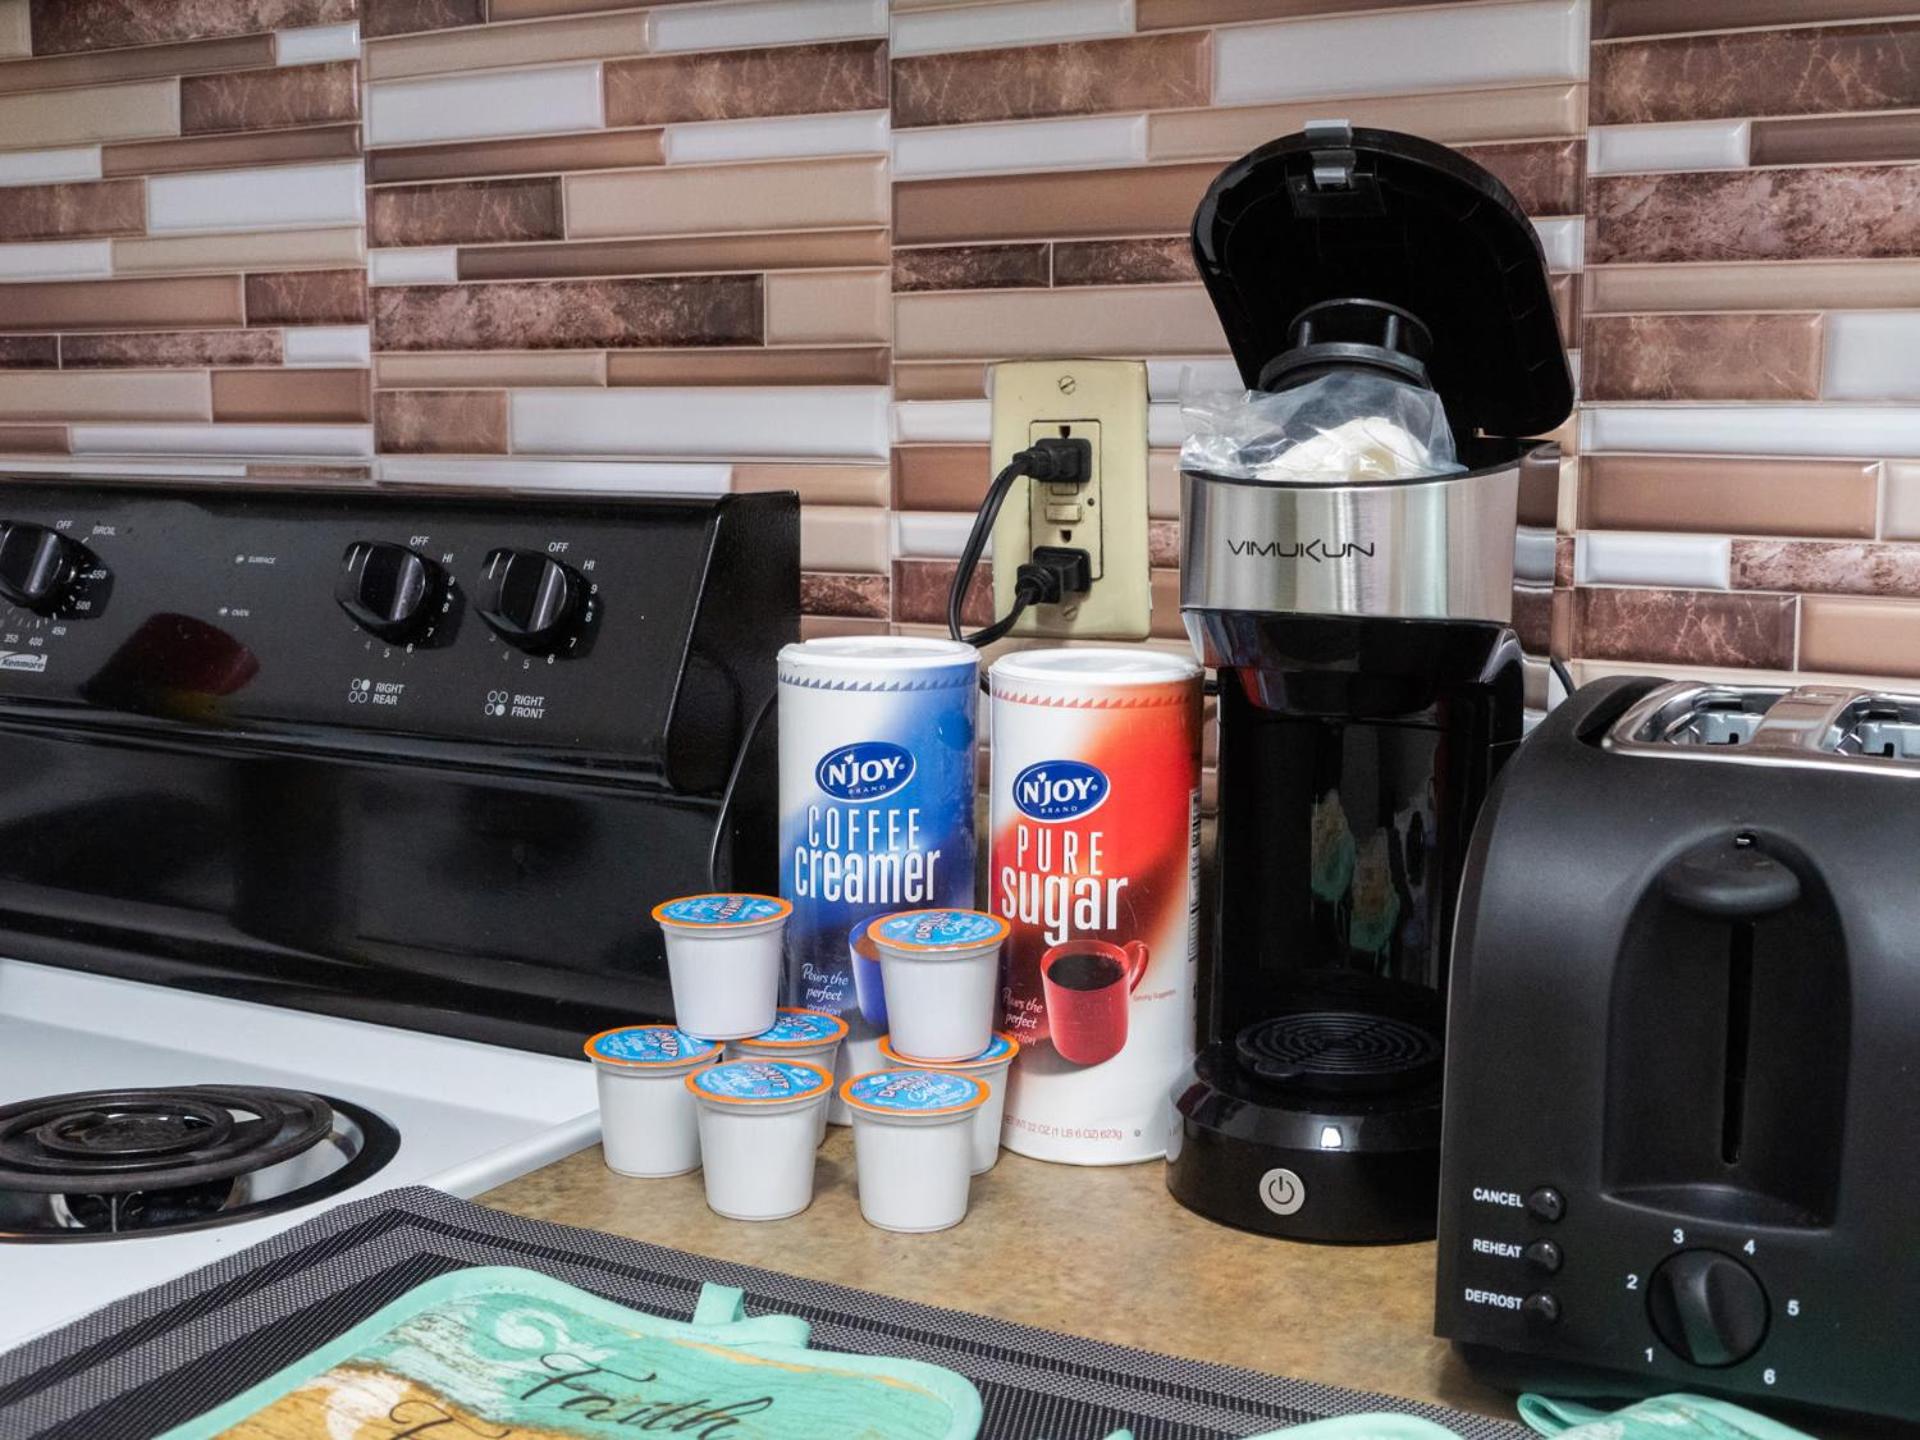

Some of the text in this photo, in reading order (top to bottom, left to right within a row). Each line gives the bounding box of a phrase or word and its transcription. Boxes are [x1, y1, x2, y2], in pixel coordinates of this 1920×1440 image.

[56, 520, 73, 530] OFF
[409, 536, 430, 546] OFF
[548, 542, 569, 553] OFF
[1228, 538, 1375, 563] VIMUKUN
[442, 553, 454, 563] HI
[583, 560, 595, 571] HI
[448, 576, 455, 587] 9
[591, 584, 598, 595] 9
[75, 601, 92, 611] 500
[442, 602, 449, 613] 8
[585, 611, 592, 623] 8
[51, 626, 67, 636] 450
[426, 627, 435, 638] 7
[569, 636, 578, 648] 7
[383, 648, 390, 659] 5
[406, 643, 414, 654] 6
[523, 658, 531, 670] 5
[548, 653, 556, 665] 6
[375, 682, 404, 694] RIGHT
[372, 694, 398, 706] REAR
[513, 694, 544, 707] RIGHT
[510, 706, 545, 720] FRONT
[1040, 805, 1078, 814] BRAND
[808, 804, 920, 851] COFFEE
[1017, 823, 1104, 876] PURE
[802, 963, 849, 985] Pours the
[805, 985, 842, 1003] perfect
[1025, 998, 1043, 1013] the
[1004, 1011, 1038, 1029] perfect
[1473, 1187, 1524, 1208] CANCEL
[1673, 1229, 1684, 1244] 3
[1472, 1238, 1522, 1259] REHEAT
[1743, 1240, 1755, 1255] 4
[1626, 1274, 1638, 1290] 2
[1464, 1288, 1523, 1310] DEFROST
[1787, 1300, 1799, 1316] 5
[1645, 1348, 1654, 1363] 1
[1763, 1369, 1776, 1385] 6
